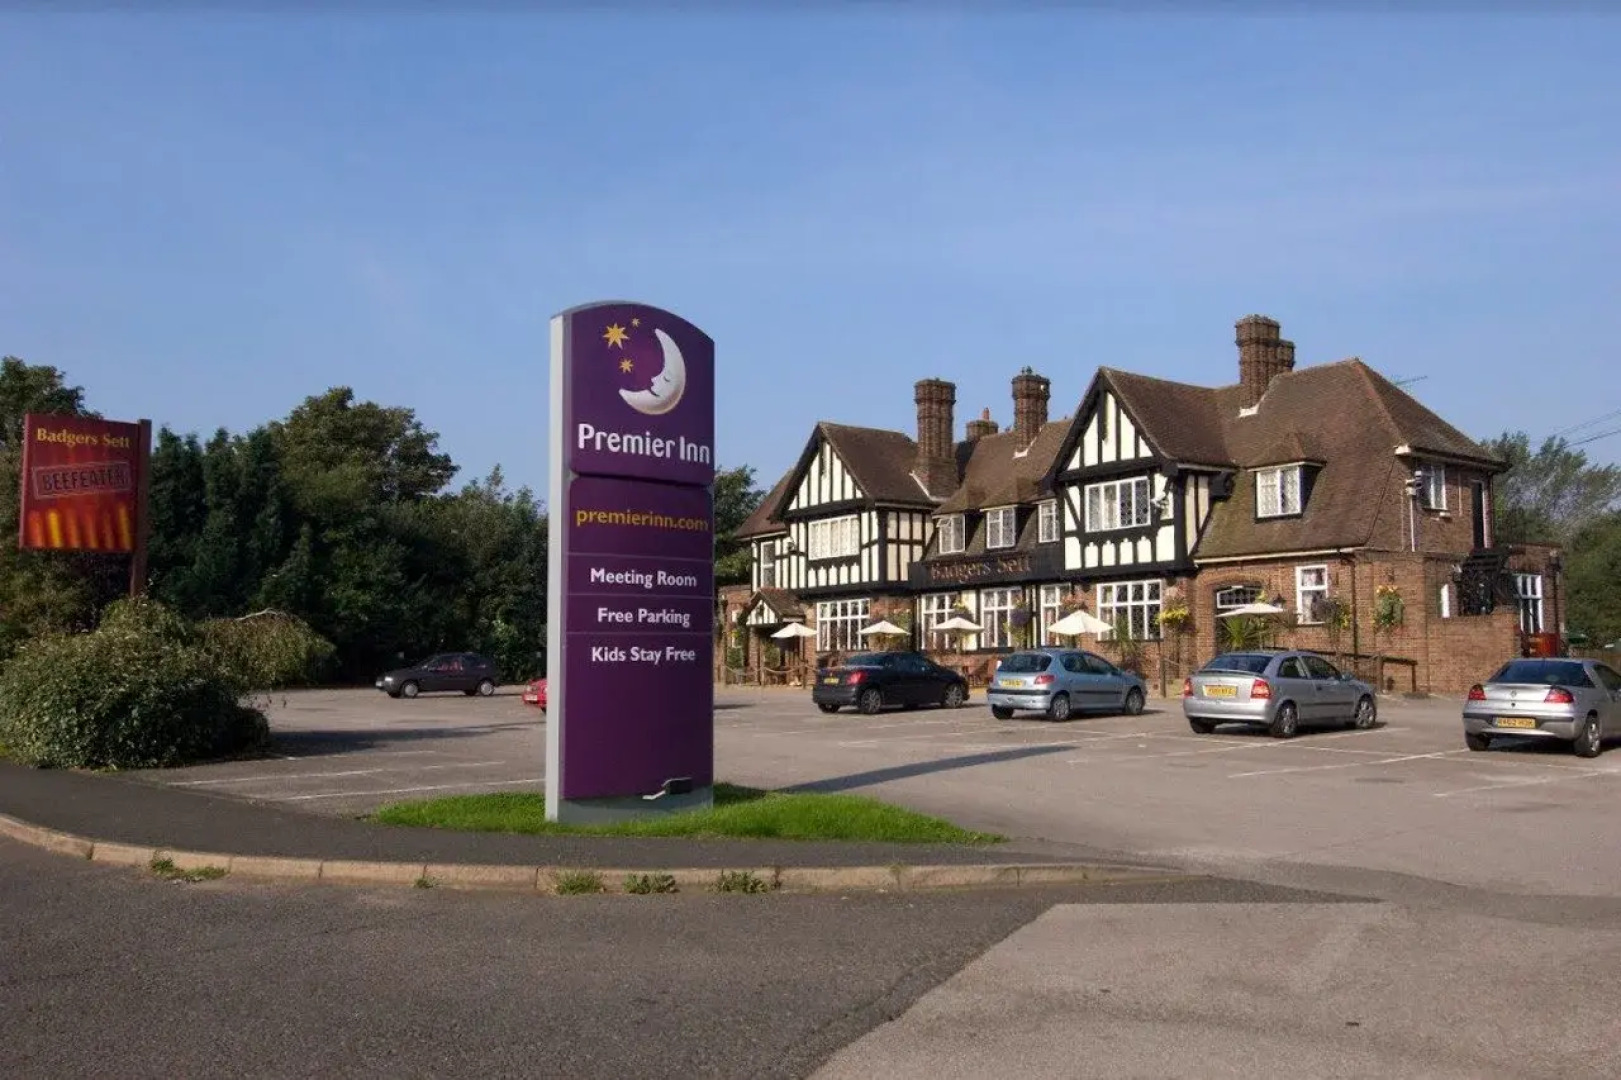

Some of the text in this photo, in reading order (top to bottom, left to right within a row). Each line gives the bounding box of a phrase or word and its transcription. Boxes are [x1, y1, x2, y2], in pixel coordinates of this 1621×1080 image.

[36, 427, 130, 448] Badgers Sett
[578, 423, 710, 464] Premier Inn
[576, 509, 709, 531] premierinn.com
[590, 568, 697, 589] Meeting Room
[597, 607, 691, 627] Free Parking
[592, 646, 696, 665] Kids Stay Free
